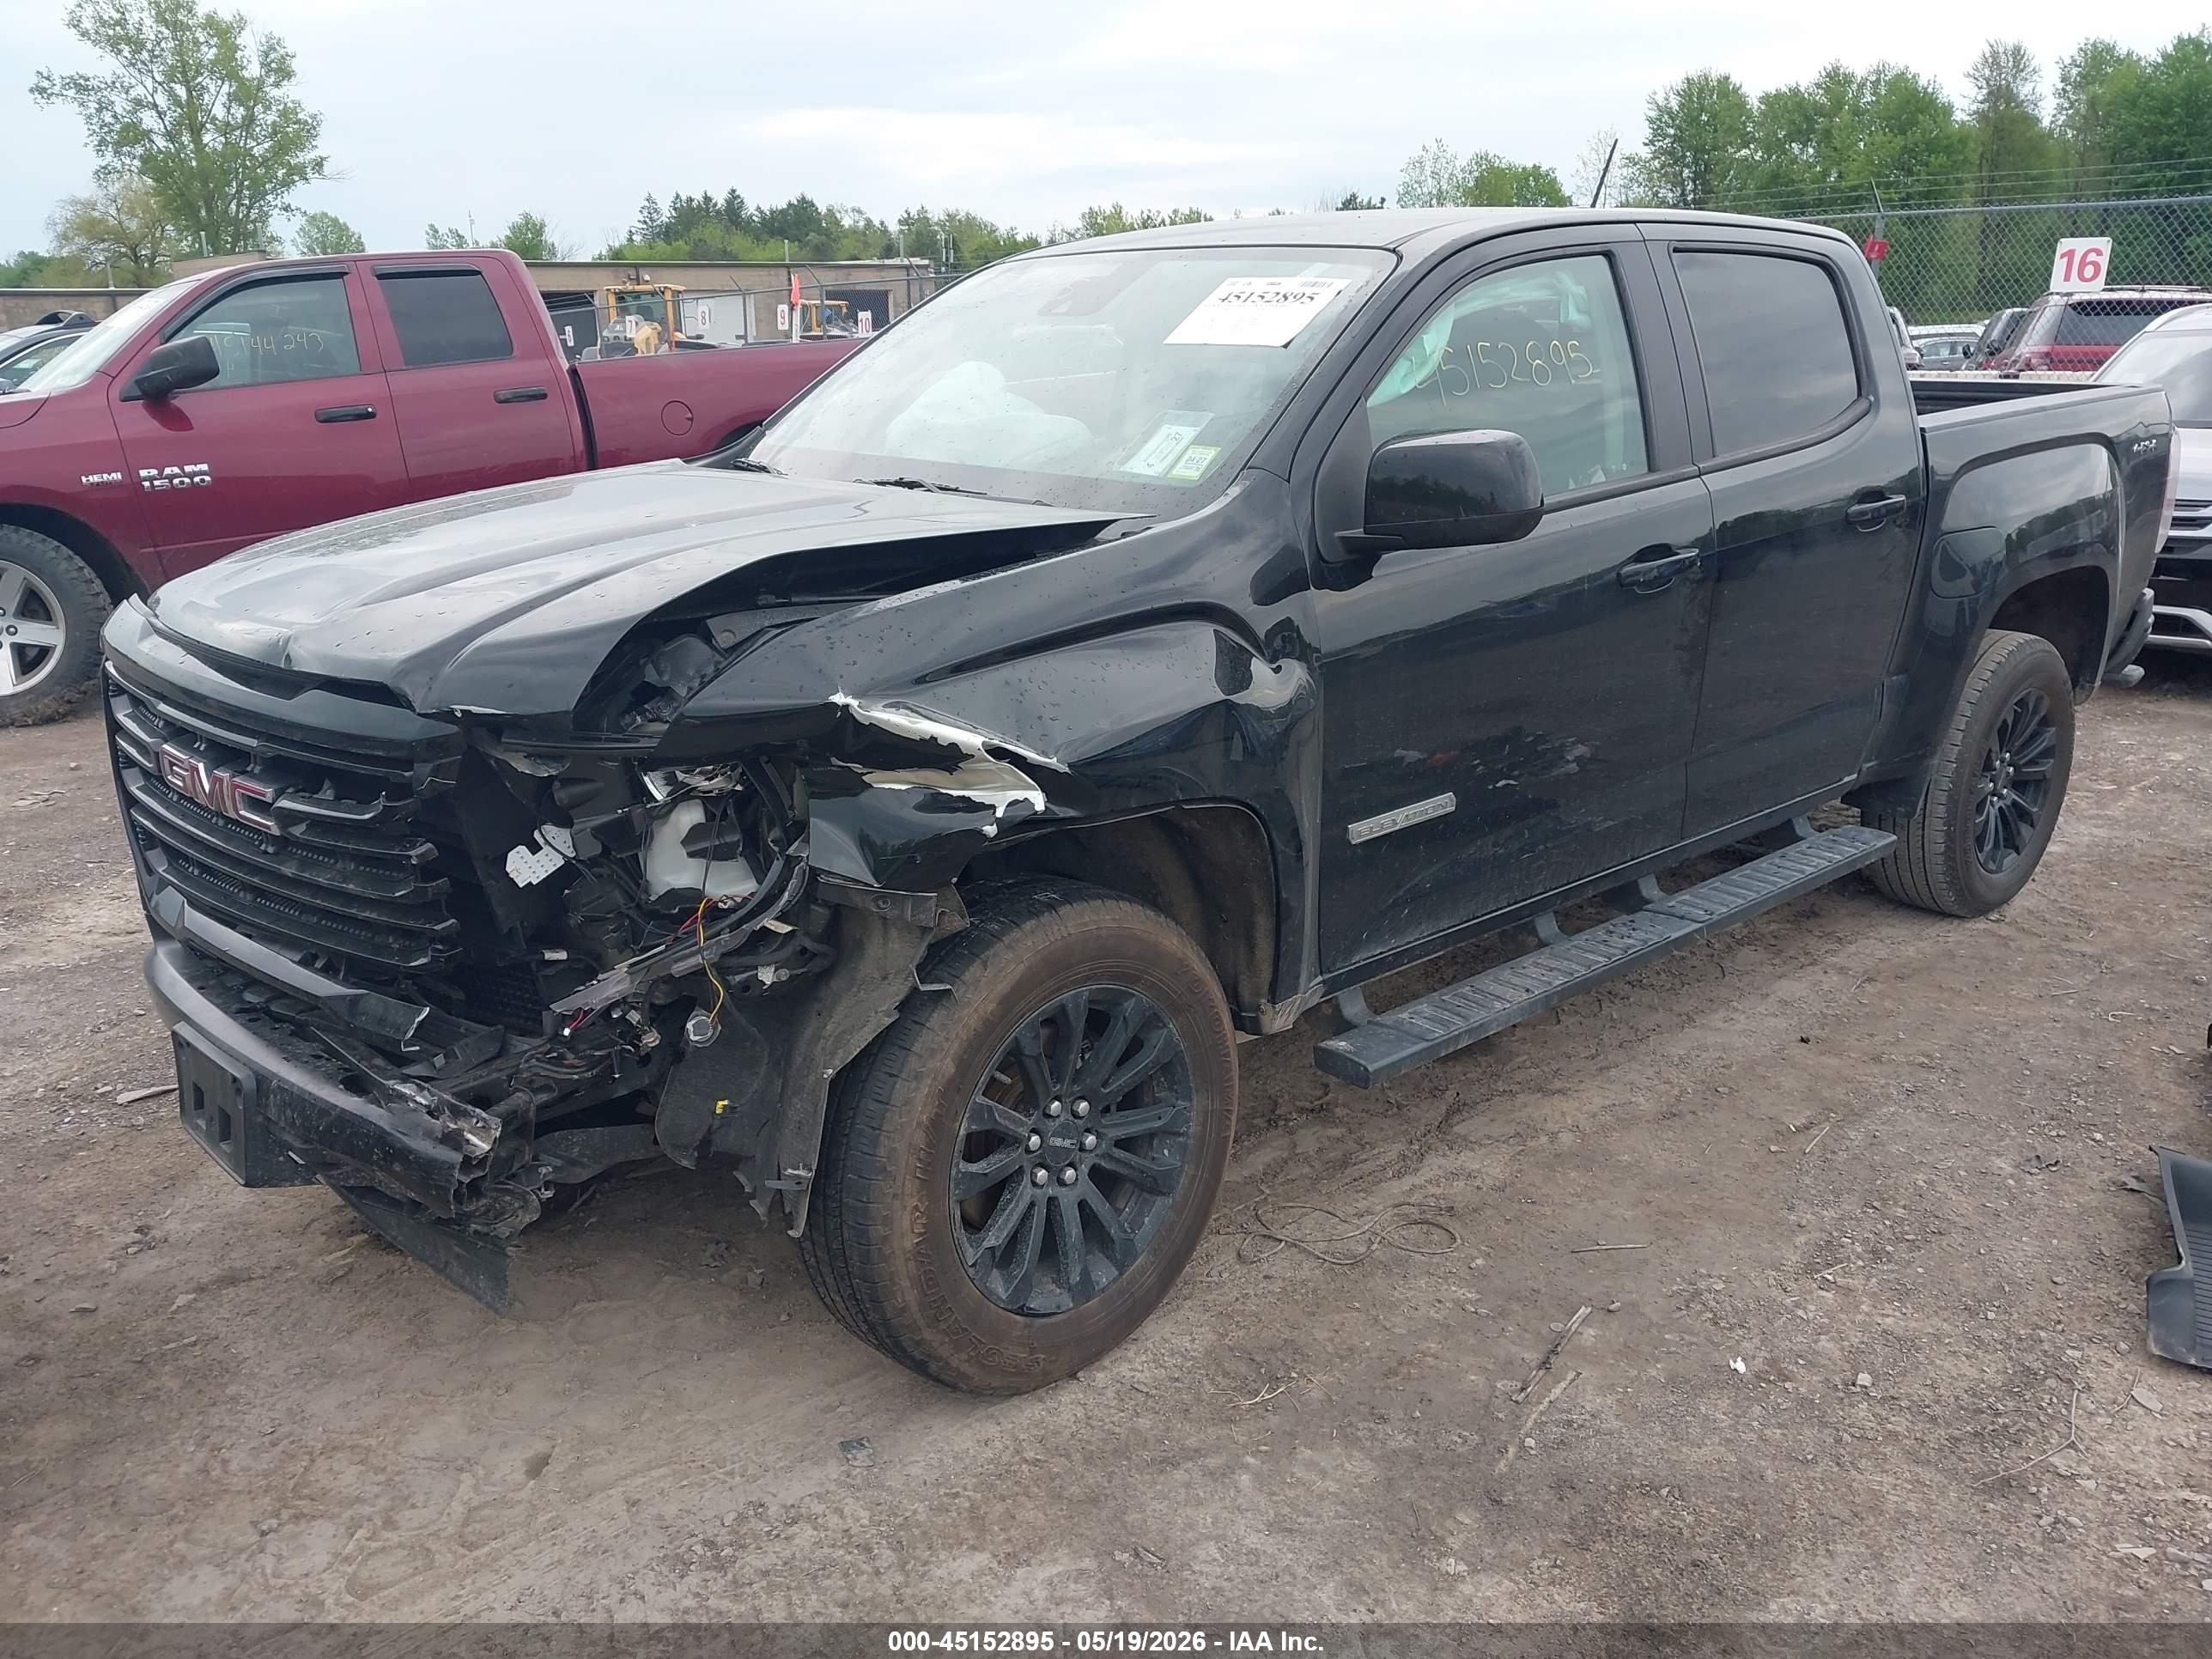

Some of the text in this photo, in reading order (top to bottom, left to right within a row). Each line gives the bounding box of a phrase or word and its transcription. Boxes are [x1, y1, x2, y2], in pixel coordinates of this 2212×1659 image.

[2059, 247, 2104, 283] 16
[1218, 291, 1321, 304] 45152895
[700, 311, 707, 325] 8
[780, 309, 785, 325] 9
[628, 319, 634, 334] 7
[860, 318, 871, 333] 10
[1412, 340, 1601, 406] 45152895
[81, 471, 123, 483] HEMI
[138, 463, 210, 479] RAM
[141, 475, 212, 492] 1500
[159, 743, 282, 836] GMC
[1358, 799, 1450, 836] ELEVATION
[1049, 1137, 1077, 1149] GMC
